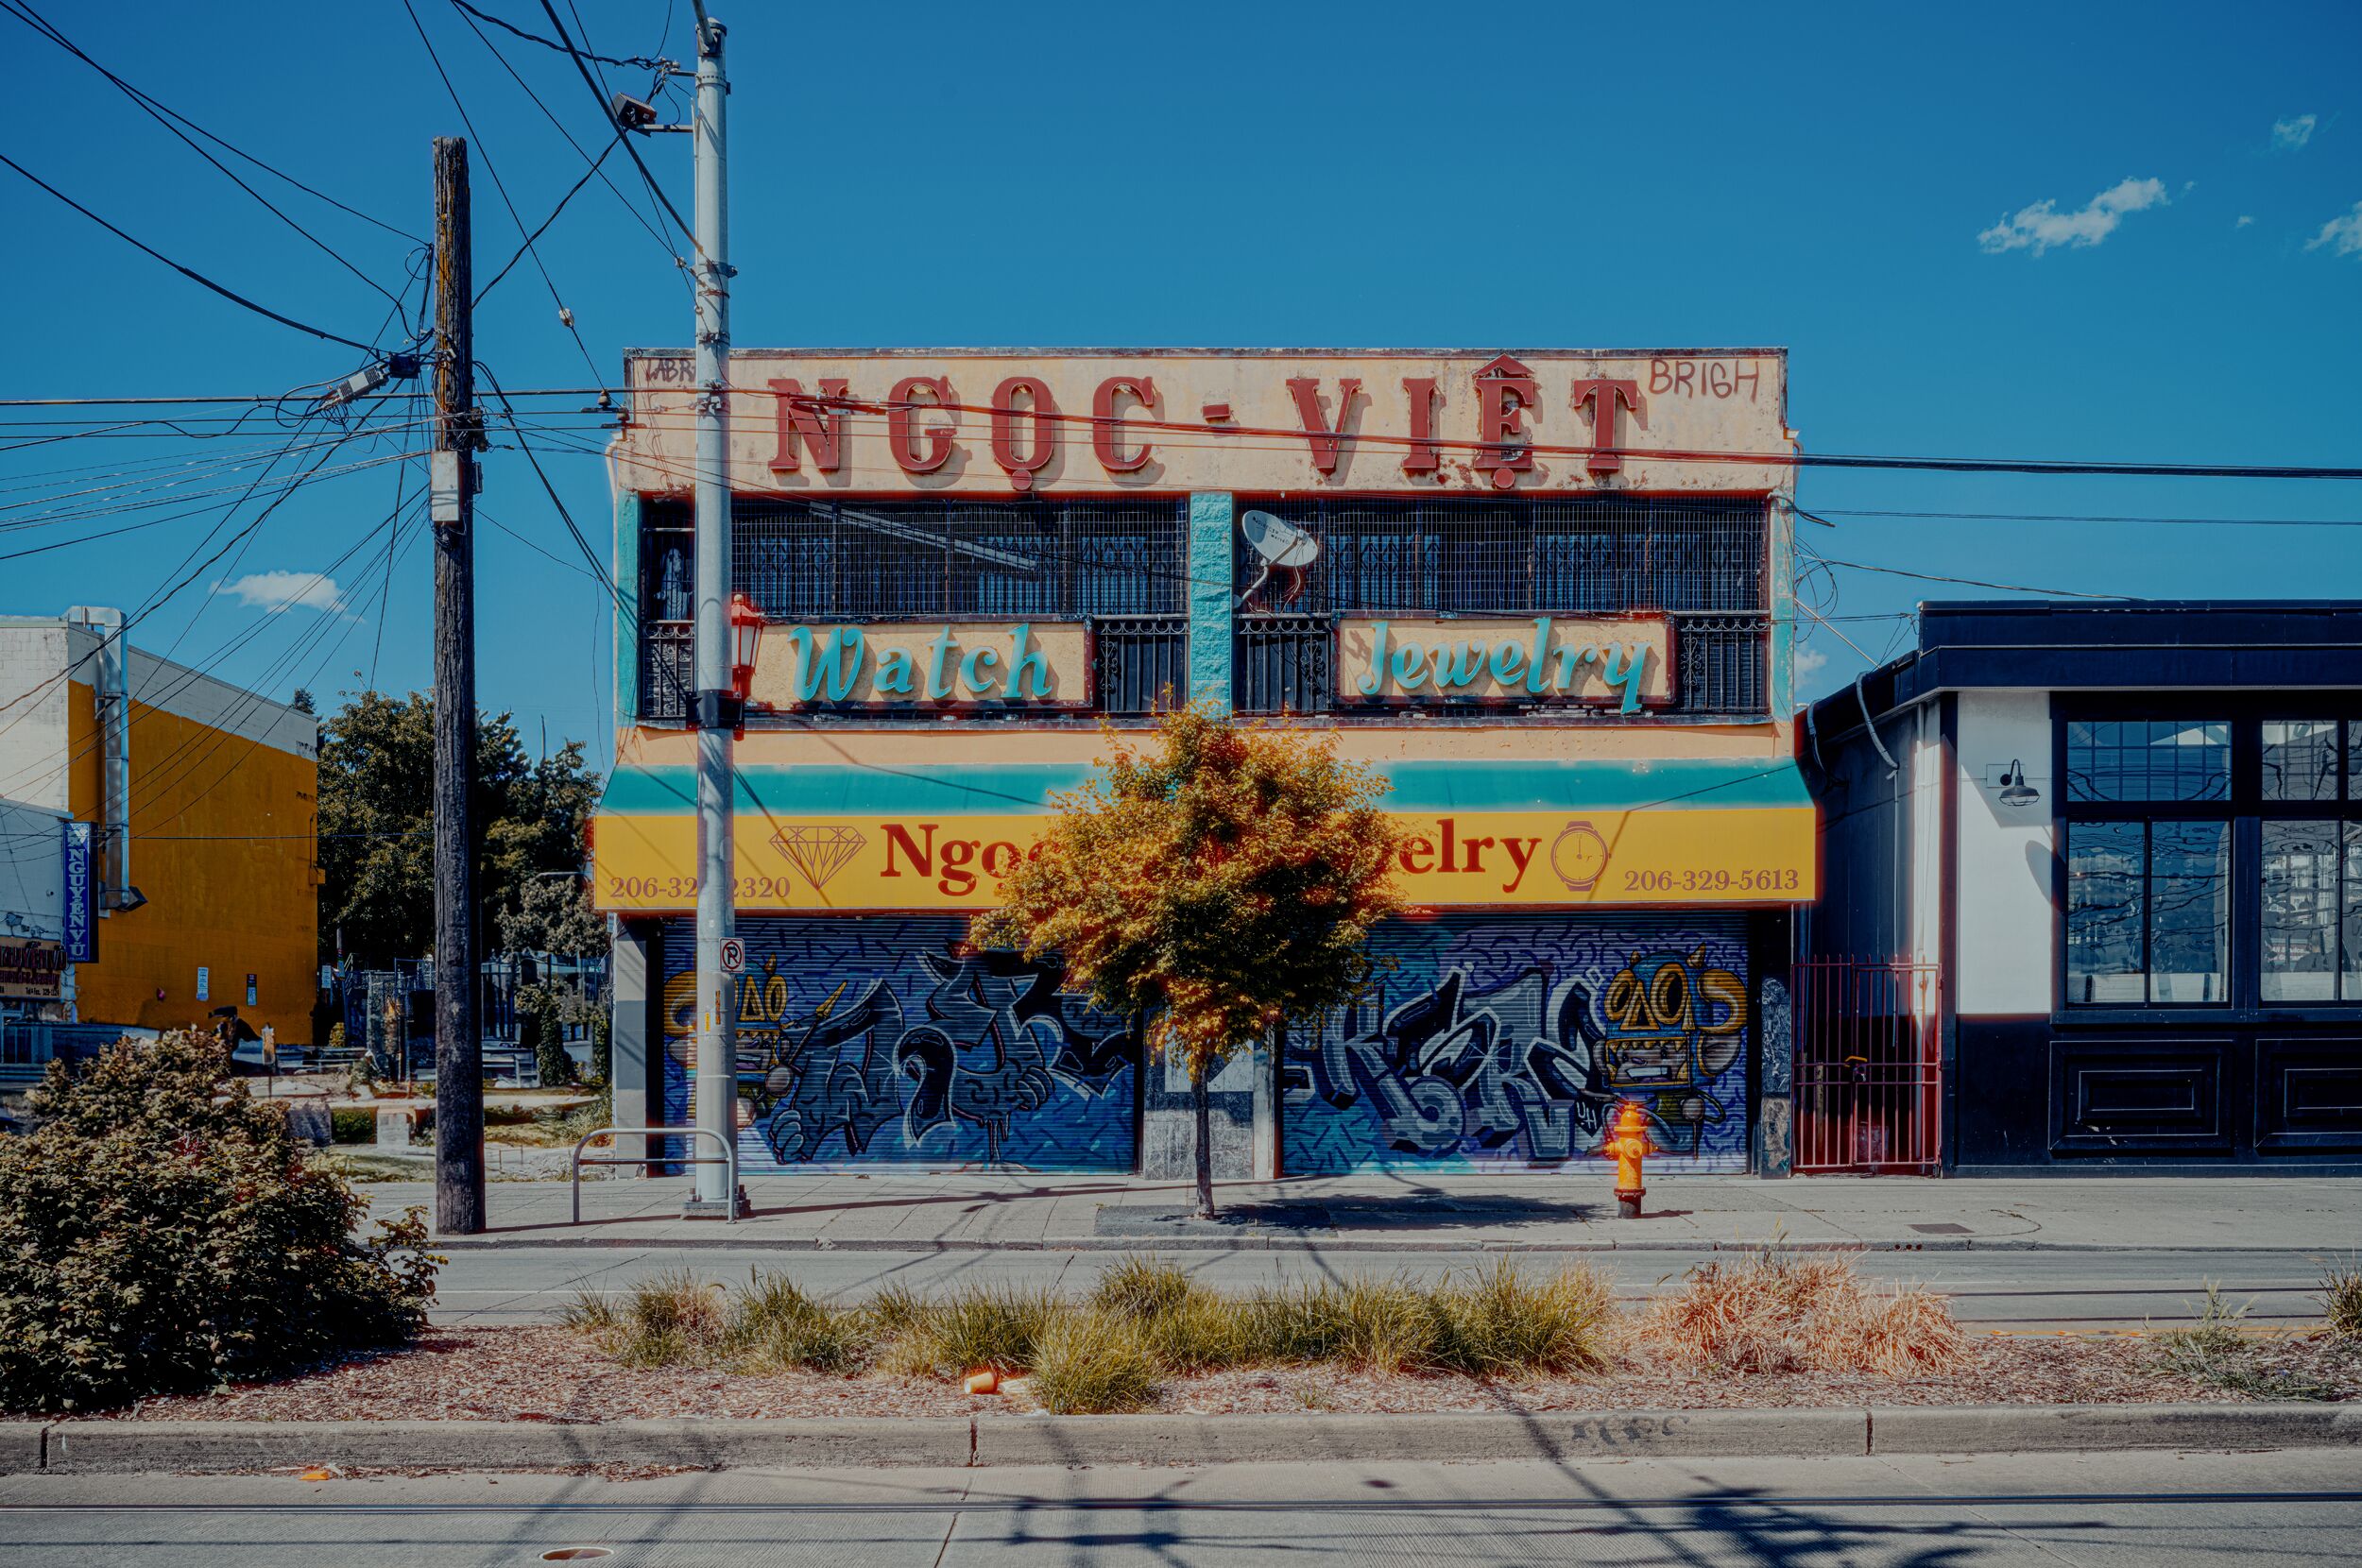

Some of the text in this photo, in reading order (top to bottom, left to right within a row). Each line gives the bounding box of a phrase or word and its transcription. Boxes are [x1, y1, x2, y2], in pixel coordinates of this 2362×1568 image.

[1649, 359, 1760, 403] BRIGH
[788, 623, 1053, 702] Watch
[1357, 617, 1653, 714] Jewelry
[1398, 818, 1543, 894] elry
[1624, 869, 1799, 892] 206-329-5613
[609, 877, 792, 898] 206-32320
